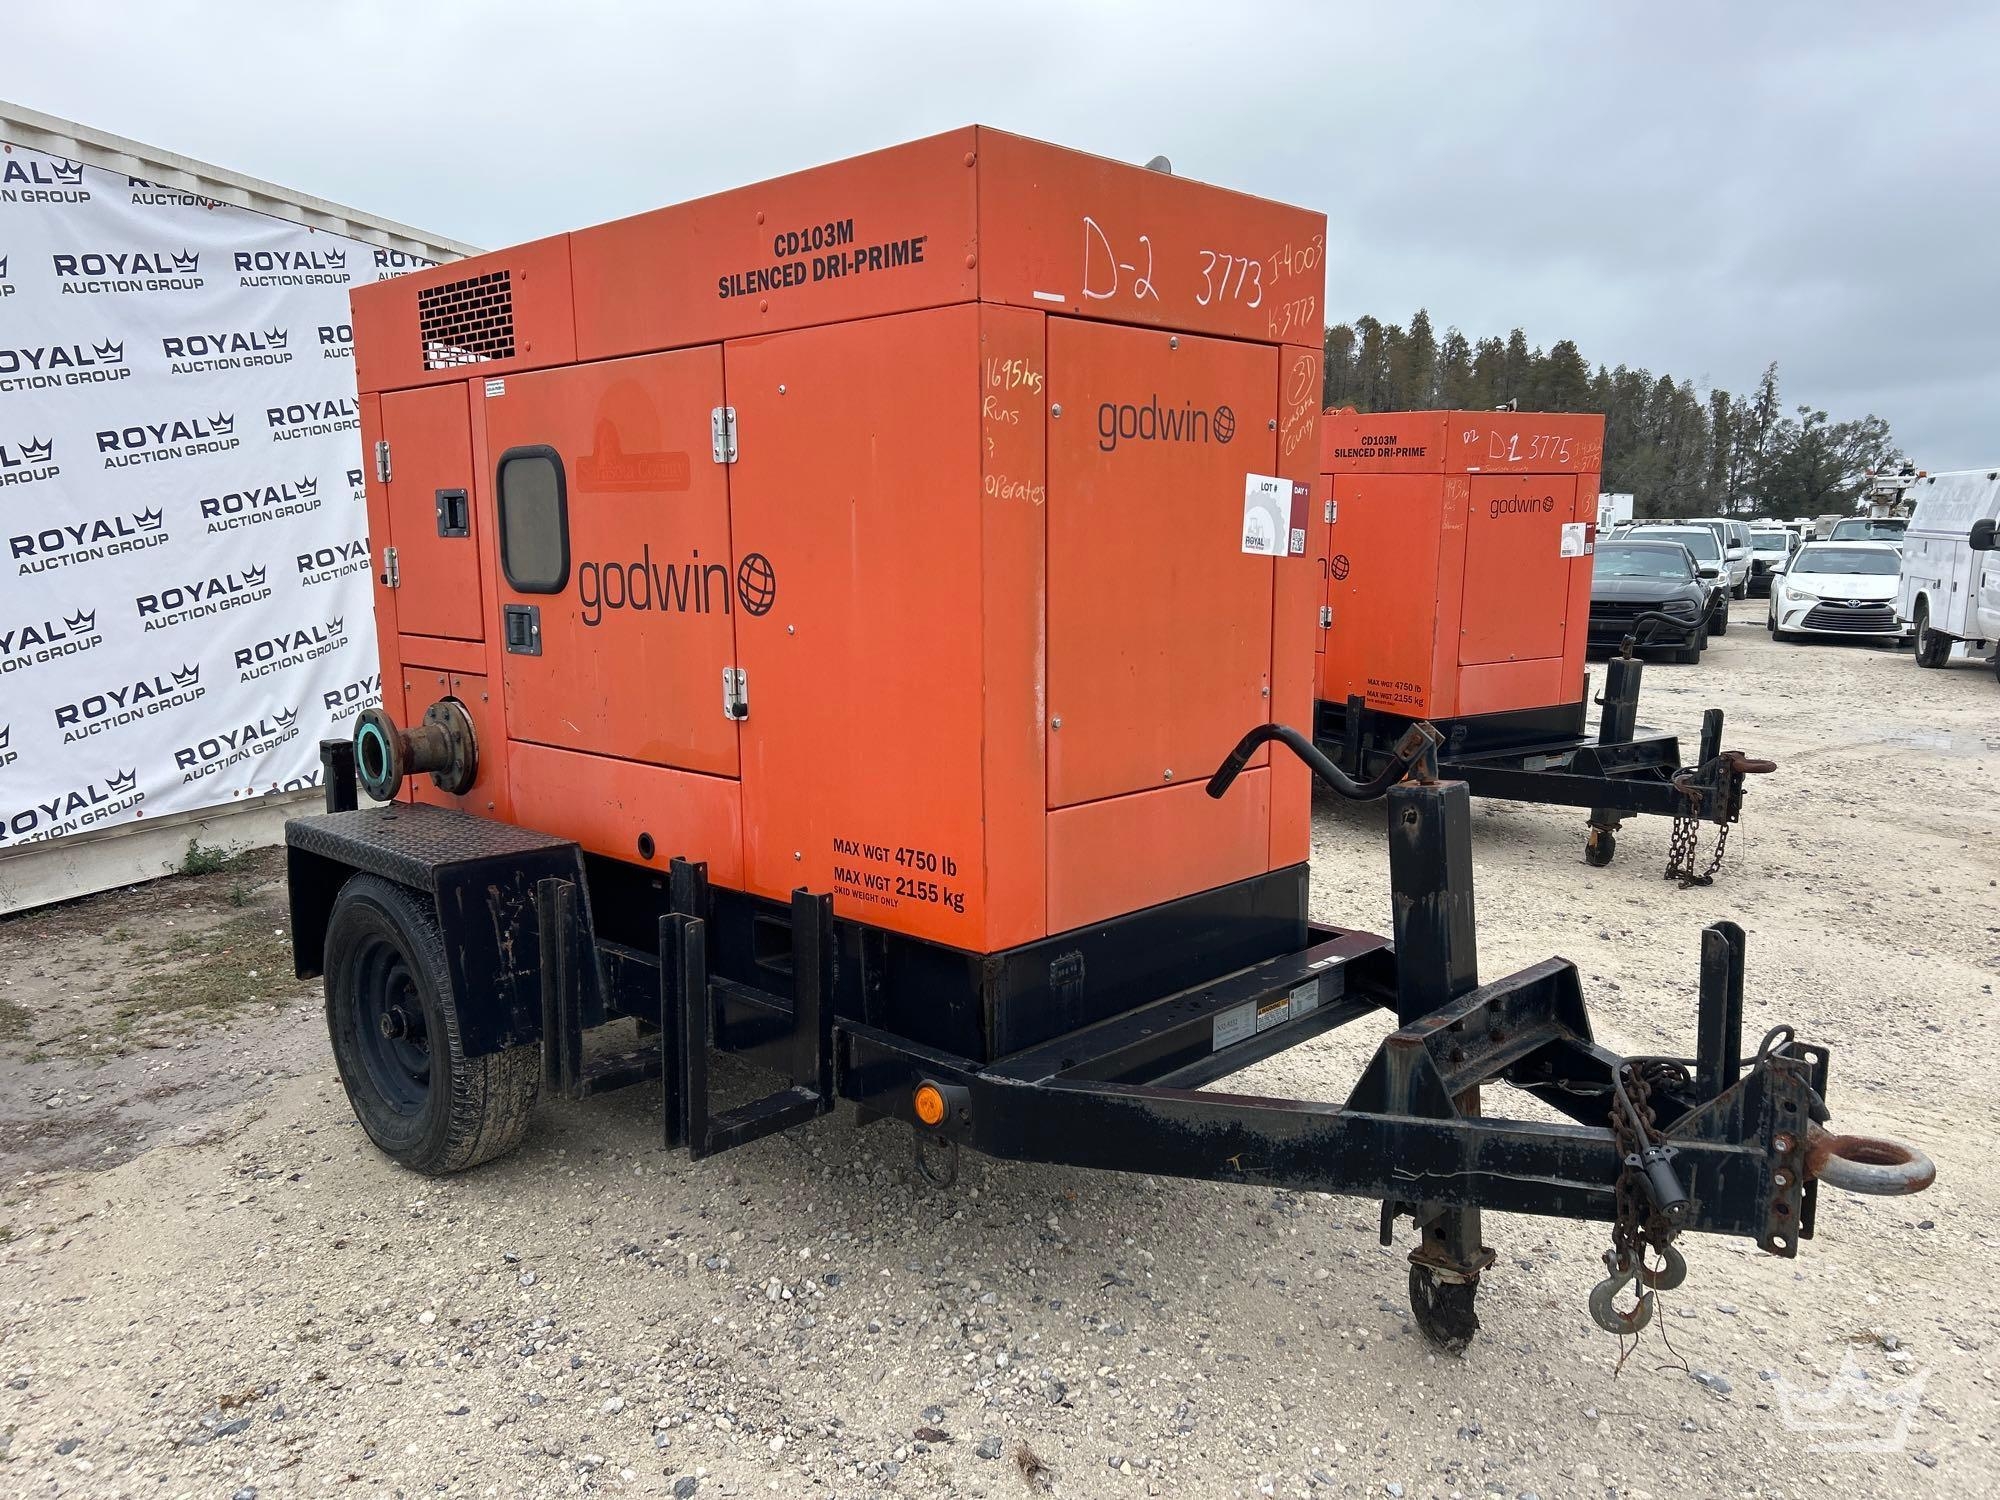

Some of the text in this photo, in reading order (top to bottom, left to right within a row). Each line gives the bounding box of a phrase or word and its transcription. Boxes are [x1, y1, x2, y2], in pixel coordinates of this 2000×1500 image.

[21, 189, 91, 203] GROUP
[131, 193, 208, 207] AUCTION
[774, 219, 854, 258] CD103M
[53, 252, 173, 277] ROYAL
[234, 251, 325, 272] ROYAL
[1082, 216, 1263, 308] D-2 3773
[62, 278, 204, 294] AUCTION GROUP
[239, 273, 351, 288] AUCTION GROUP
[718, 261, 807, 299] SILENCED
[0, 345, 95, 373] OYAL
[162, 331, 266, 359] ROYAL
[171, 353, 293, 375] AUCTION GROUP
[0, 368, 131, 392] CTION GROUP
[266, 398, 354, 427] ROYAL
[983, 395, 1020, 425] Runs
[1099, 394, 1207, 452] godwin
[96, 419, 210, 453] ROYAL
[273, 418, 361, 442] AUCTION GRO
[1361, 435, 1397, 446] CD103M
[104, 438, 240, 469] AUCTION GROUP
[1334, 448, 1376, 458] SILENCED
[1528, 434, 1573, 463] 3775
[0, 466, 60, 487] ROUP
[1261, 482, 1273, 492] LOT
[1294, 487, 1304, 495] DAY
[200, 483, 297, 519] ROYAL
[1490, 494, 1540, 519] godwin
[207, 500, 322, 534] AUCTION GROUP
[9, 516, 136, 559] ROYAL
[1245, 536, 1264, 546] ROYAL
[18, 533, 169, 576] AUCTION GROUP
[302, 564, 358, 587] AUCTION
[579, 543, 730, 627] godwin
[136, 574, 244, 617] ROYAL
[144, 587, 272, 632] AUCTION GROUP
[36, 634, 103, 663] GROUP
[234, 626, 328, 669] ROYAL
[240, 637, 348, 683] AUCTION GROUP
[1367, 690, 1379, 698] MAX
[1380, 692, 1392, 700] WGT
[1394, 693, 1412, 703] 2155
[1414, 697, 1424, 707] kg
[1395, 682, 1413, 691] 4750
[55, 676, 173, 729] ROYAL
[63, 687, 206, 744] AUCTION GROUP
[331, 694, 383, 723] AUCTION
[174, 719, 276, 770] ROYAL
[183, 748, 251, 784] AUCTION
[252, 728, 299, 754] GROUP
[0, 785, 109, 840] OYAL
[81, 792, 145, 826] GROUP
[833, 838, 957, 877] MAX WGT 4750 lb
[833, 885, 899, 908] SKID WEIGHT ONLY
[834, 867, 965, 913] MAX WGT 2155 kg
